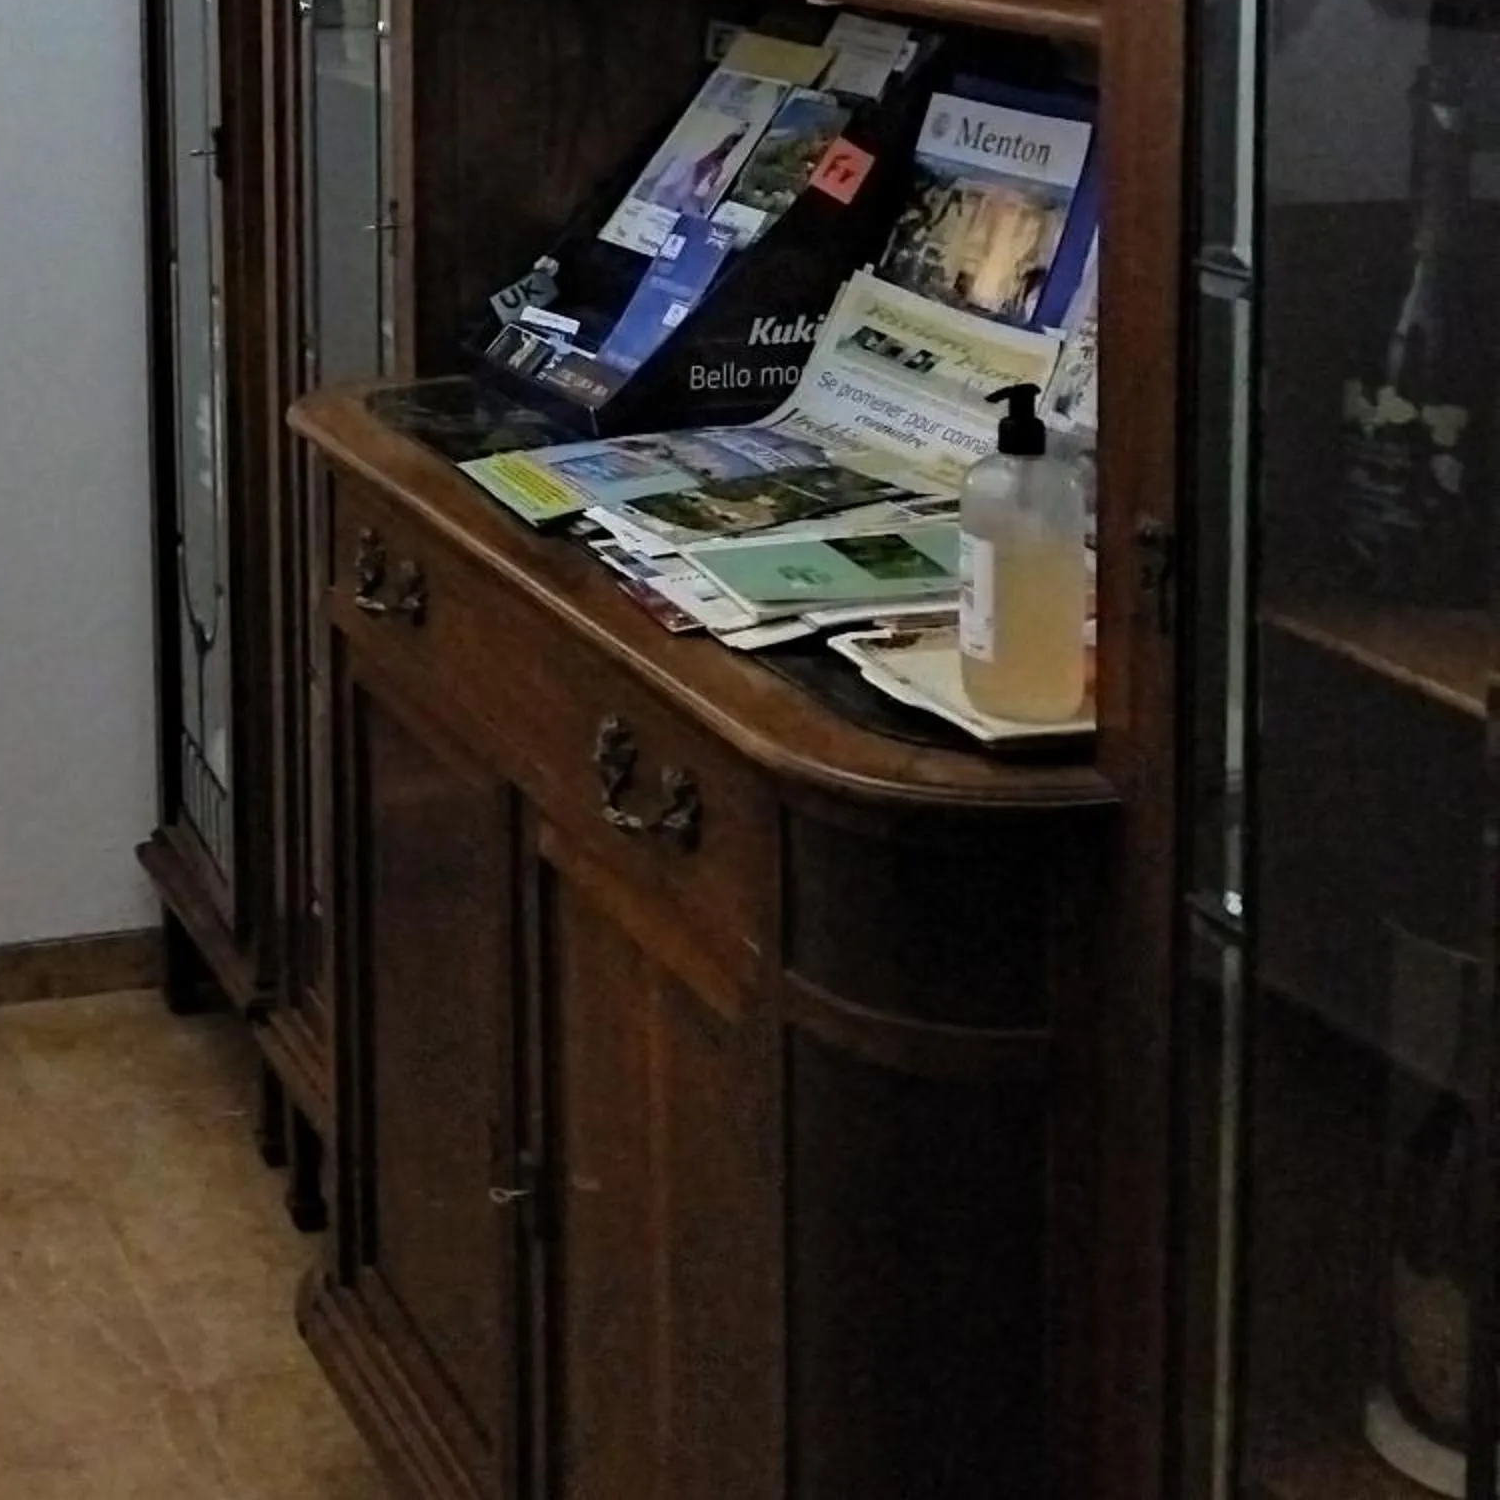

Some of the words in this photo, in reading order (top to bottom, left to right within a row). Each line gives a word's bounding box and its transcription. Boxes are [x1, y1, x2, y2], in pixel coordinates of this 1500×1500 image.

[954, 116, 1053, 166] Menton
[500, 279, 546, 309] UK
[748, 313, 827, 347] Kuki
[689, 360, 751, 391] Bello
[760, 365, 804, 388] mo
[816, 371, 835, 392] Se
[835, 381, 905, 419] promener
[901, 409, 944, 436] pour
[940, 424, 993, 456] conna
